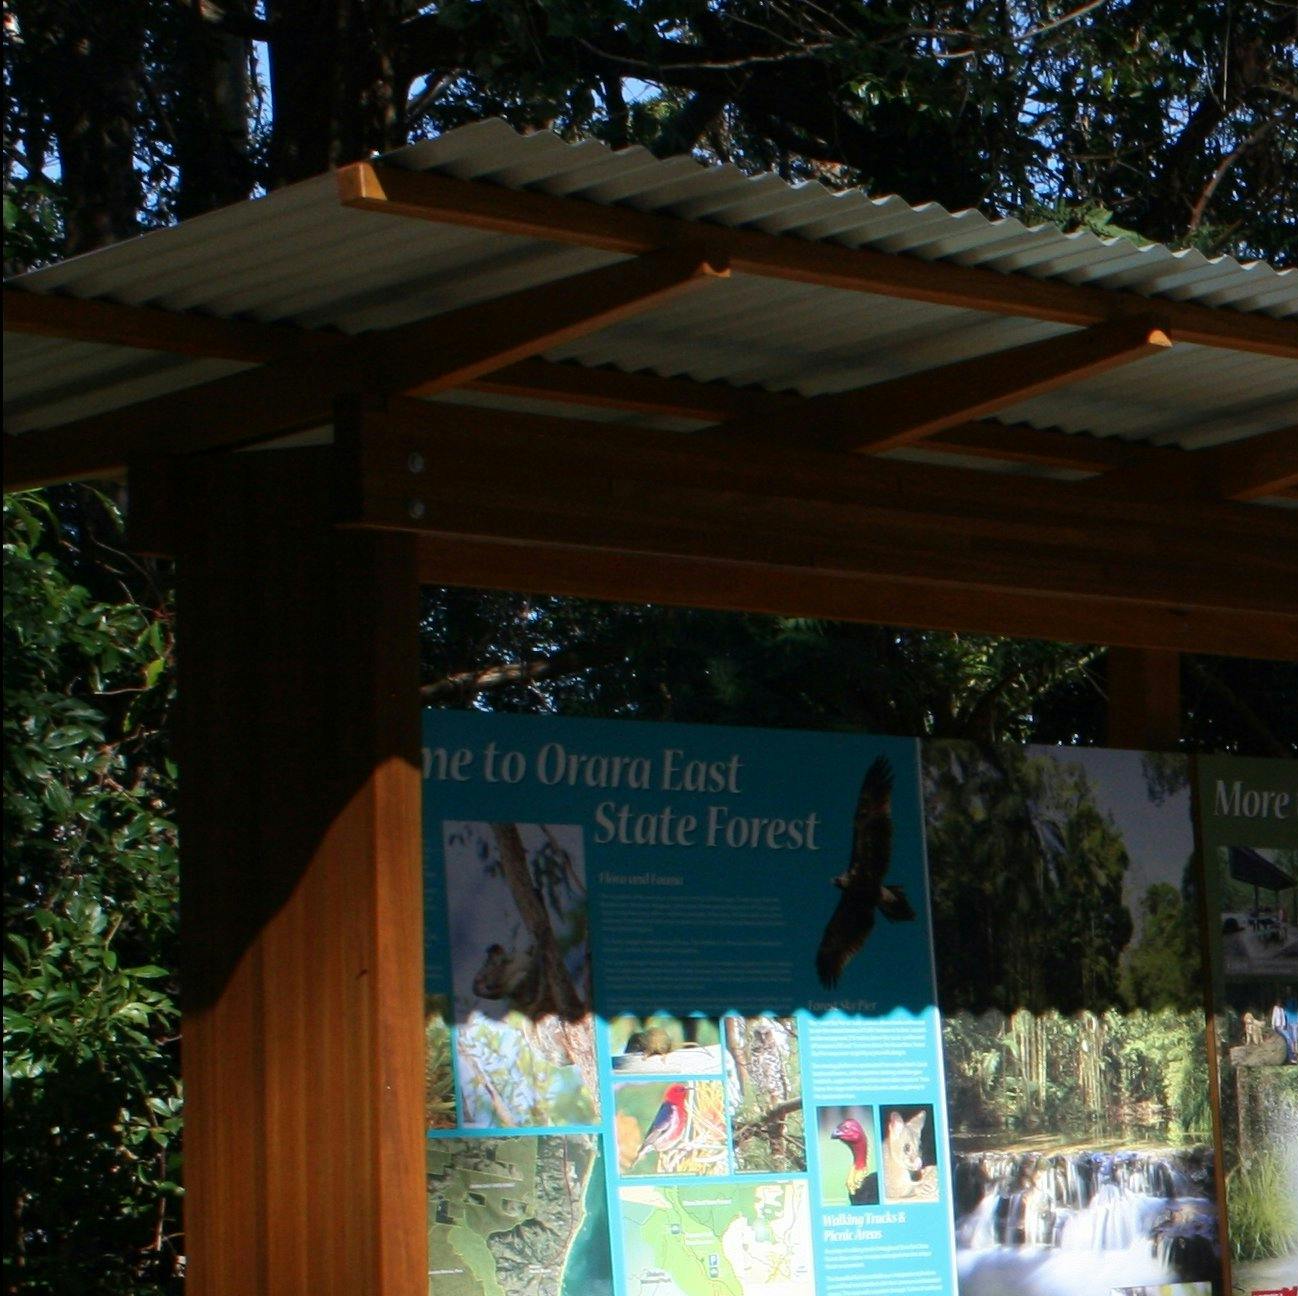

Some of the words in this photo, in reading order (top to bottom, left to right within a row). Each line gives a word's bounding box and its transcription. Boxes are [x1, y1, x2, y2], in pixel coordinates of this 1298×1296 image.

[484, 742, 527, 784] to
[537, 742, 651, 790] Orara
[661, 749, 746, 794] East
[1212, 779, 1291, 820] More
[593, 801, 698, 847] State
[706, 805, 821, 850] Forest
[822, 1213, 865, 1228] Walking
